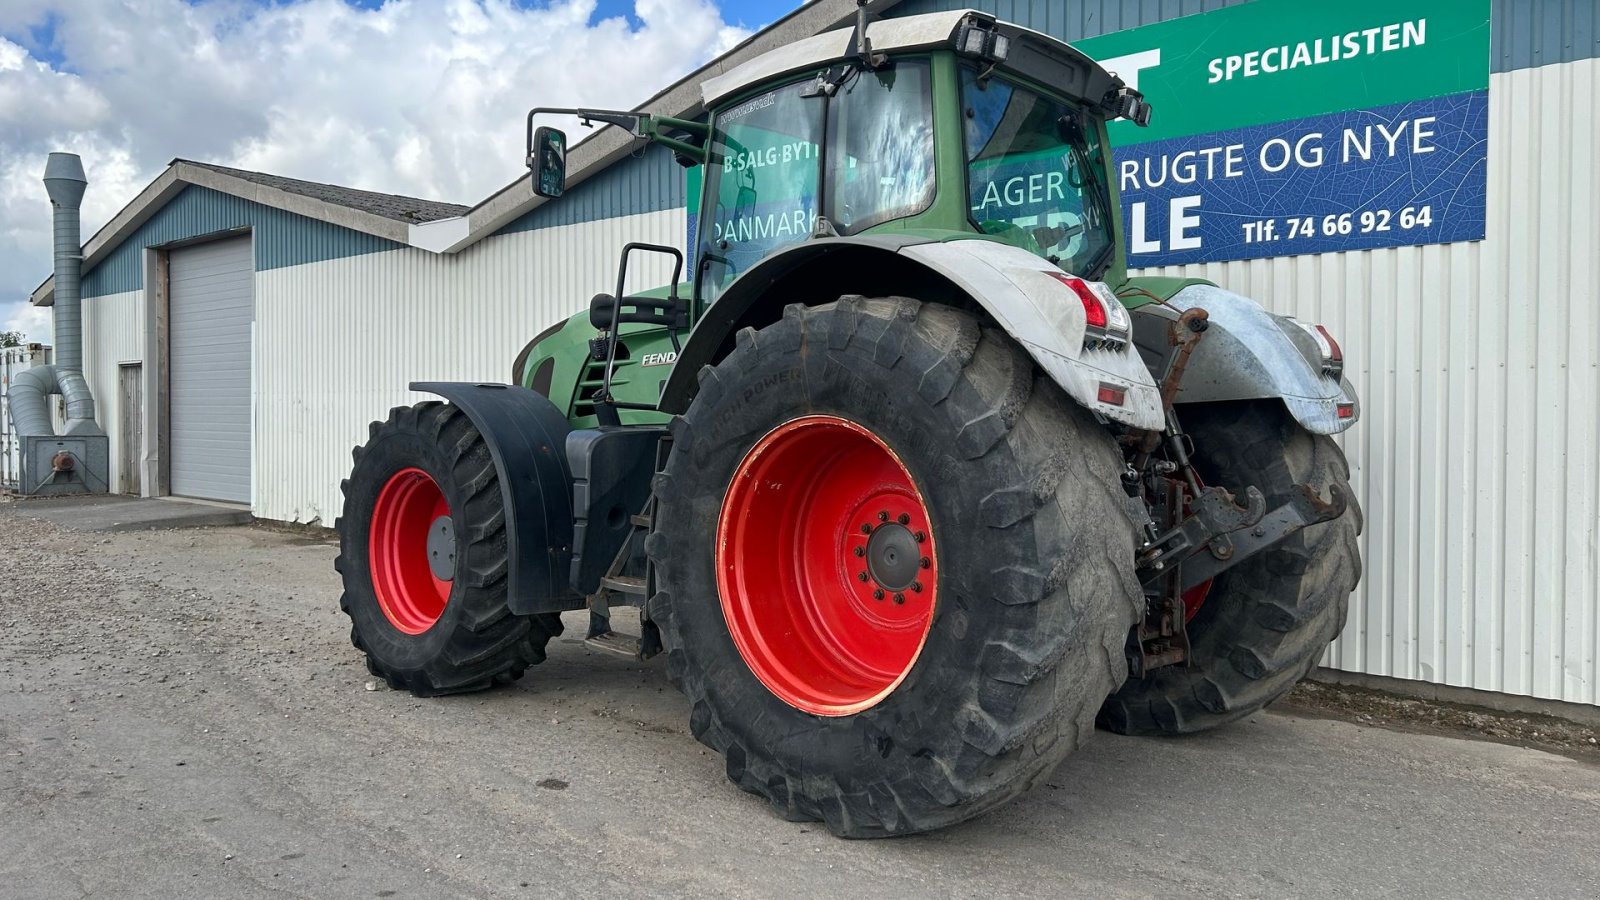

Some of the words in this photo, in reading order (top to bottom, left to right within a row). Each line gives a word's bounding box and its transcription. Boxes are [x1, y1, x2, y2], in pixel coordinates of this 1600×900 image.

[1208, 18, 1426, 84] SPECIALISTEN
[971, 171, 1065, 211] AGER
[1259, 133, 1323, 173] OG
[1342, 116, 1436, 163] NYE
[1242, 219, 1280, 243] Tlf.
[1287, 217, 1315, 239] 74
[1322, 213, 1352, 236] 66
[1360, 209, 1391, 232] 92
[1399, 206, 1432, 229] 64
